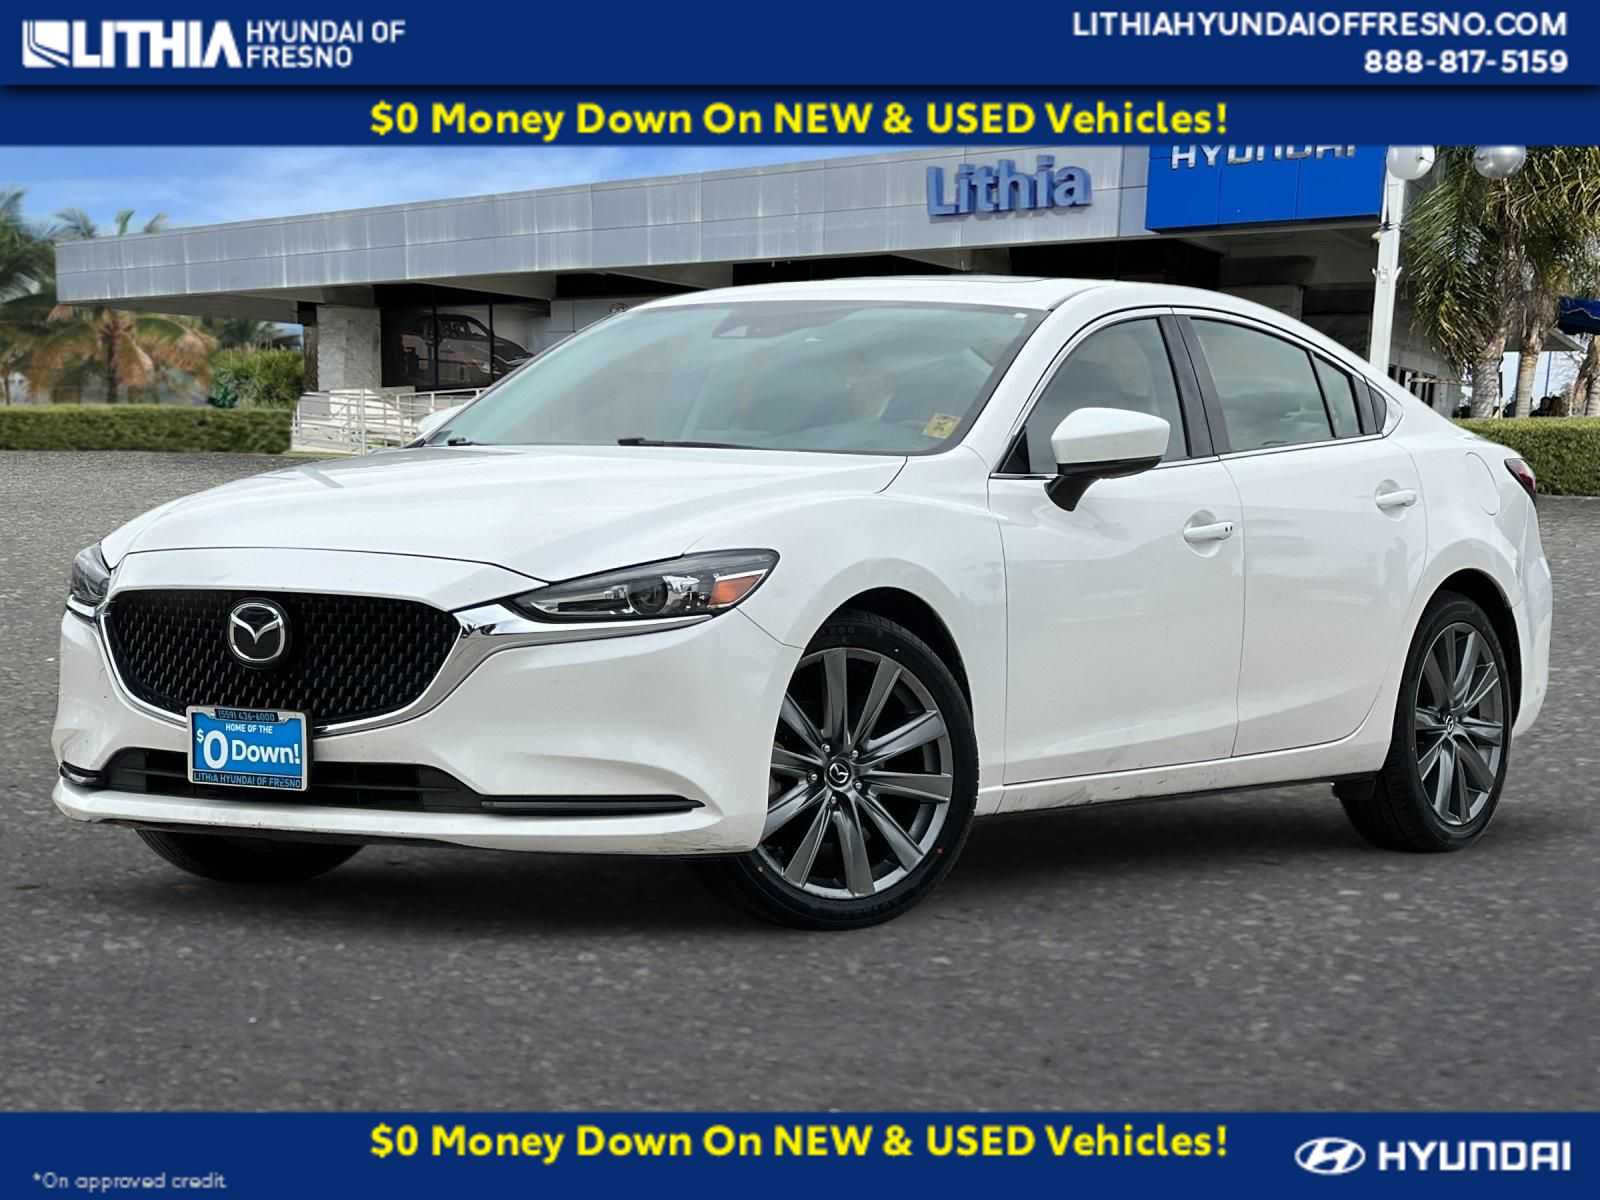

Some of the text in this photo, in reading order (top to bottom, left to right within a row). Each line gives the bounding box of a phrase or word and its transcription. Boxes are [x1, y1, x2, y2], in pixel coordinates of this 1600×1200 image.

[926, 155, 1092, 218] Lithia
[225, 723, 273, 735] HOME OF THE
[231, 740, 301, 764] Down!
[193, 771, 301, 789] LITHIA HYUNDAI OF FRESNO
